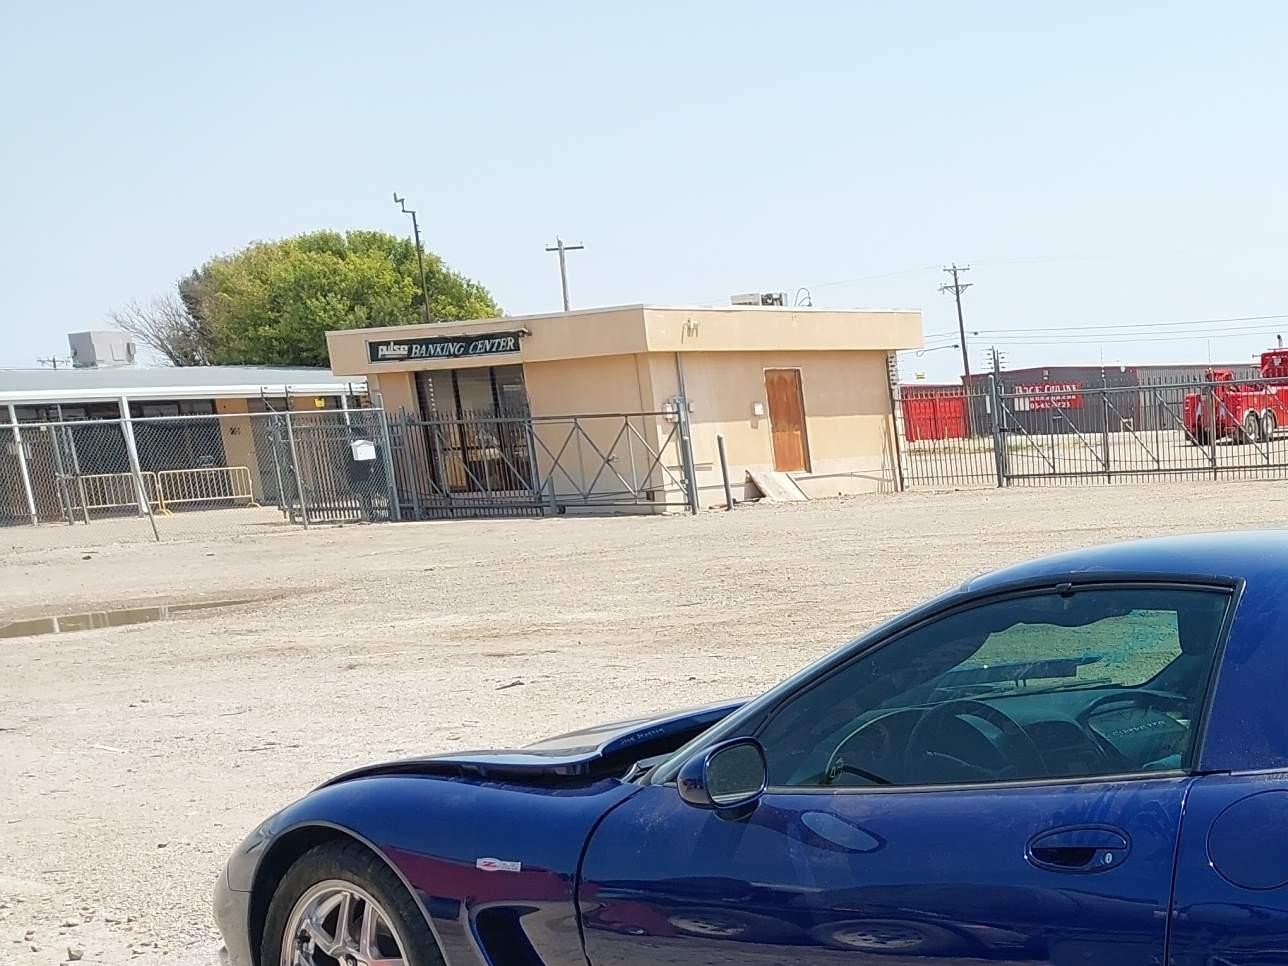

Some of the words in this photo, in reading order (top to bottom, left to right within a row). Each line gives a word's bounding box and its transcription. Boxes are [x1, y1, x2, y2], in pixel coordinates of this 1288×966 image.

[378, 341, 409, 359] pulse
[411, 342, 466, 358] BANKING
[469, 336, 515, 354] CENTER
